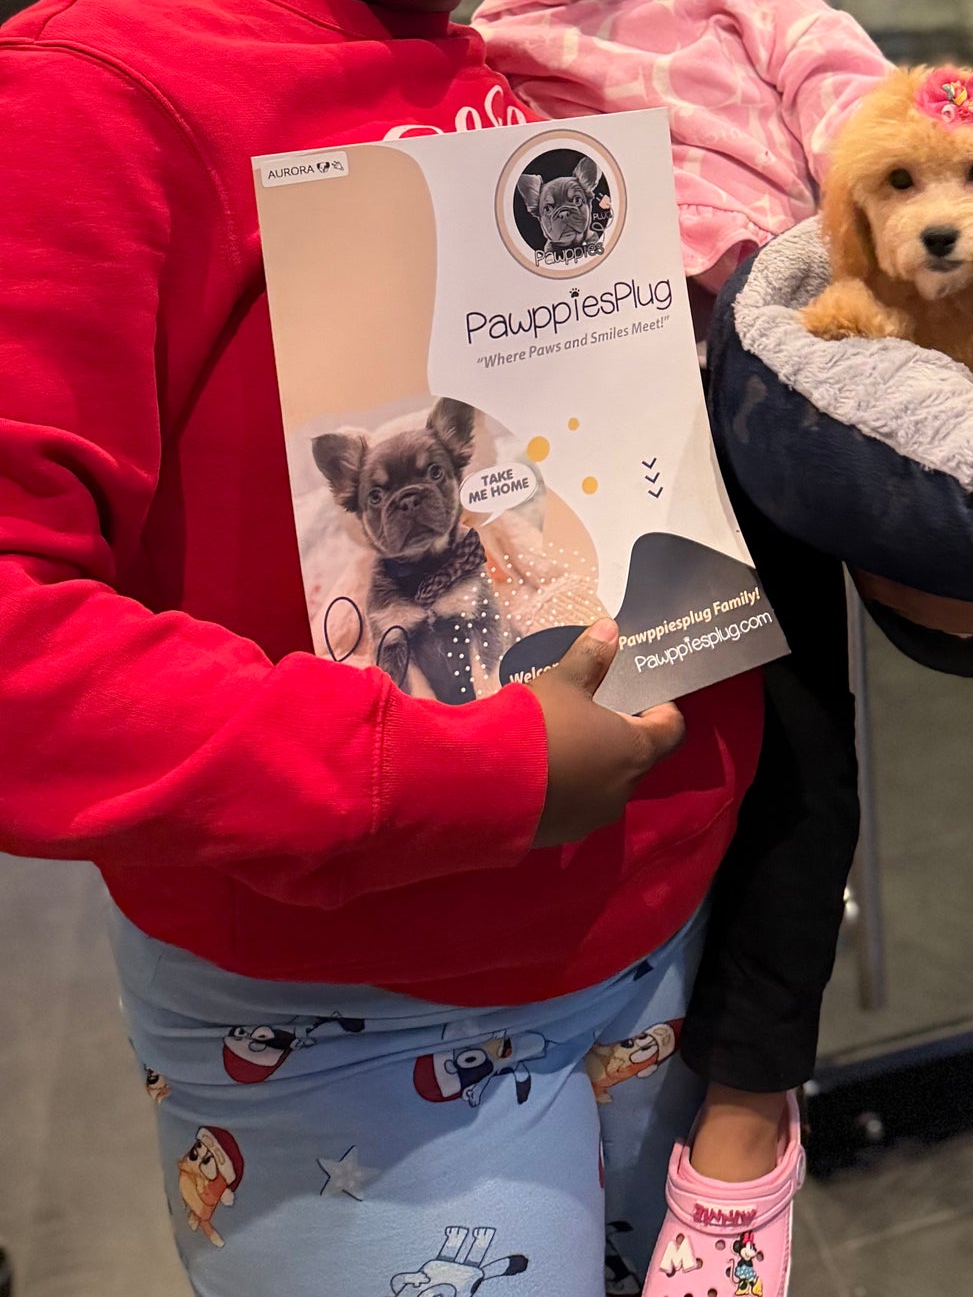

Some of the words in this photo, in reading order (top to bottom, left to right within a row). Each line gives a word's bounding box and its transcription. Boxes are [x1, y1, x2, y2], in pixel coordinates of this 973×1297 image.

[268, 165, 315, 180] AURORA
[534, 242, 605, 267] Pawppies
[466, 279, 673, 345] PawppiesPlug
[476, 349, 531, 369] “Where
[529, 342, 562, 358] Paws
[564, 333, 588, 350] and
[590, 325, 629, 344] Smiles
[631, 315, 670, 335] Meet!”
[468, 489, 488, 504] ME
[490, 477, 530, 498] HOME
[481, 469, 514, 486] TAKE
[618, 607, 712, 651] Pawppiesplug
[713, 586, 761, 616] Family!
[634, 611, 773, 673] Pawppiesplug.com
[659, 1236, 697, 1274] M
